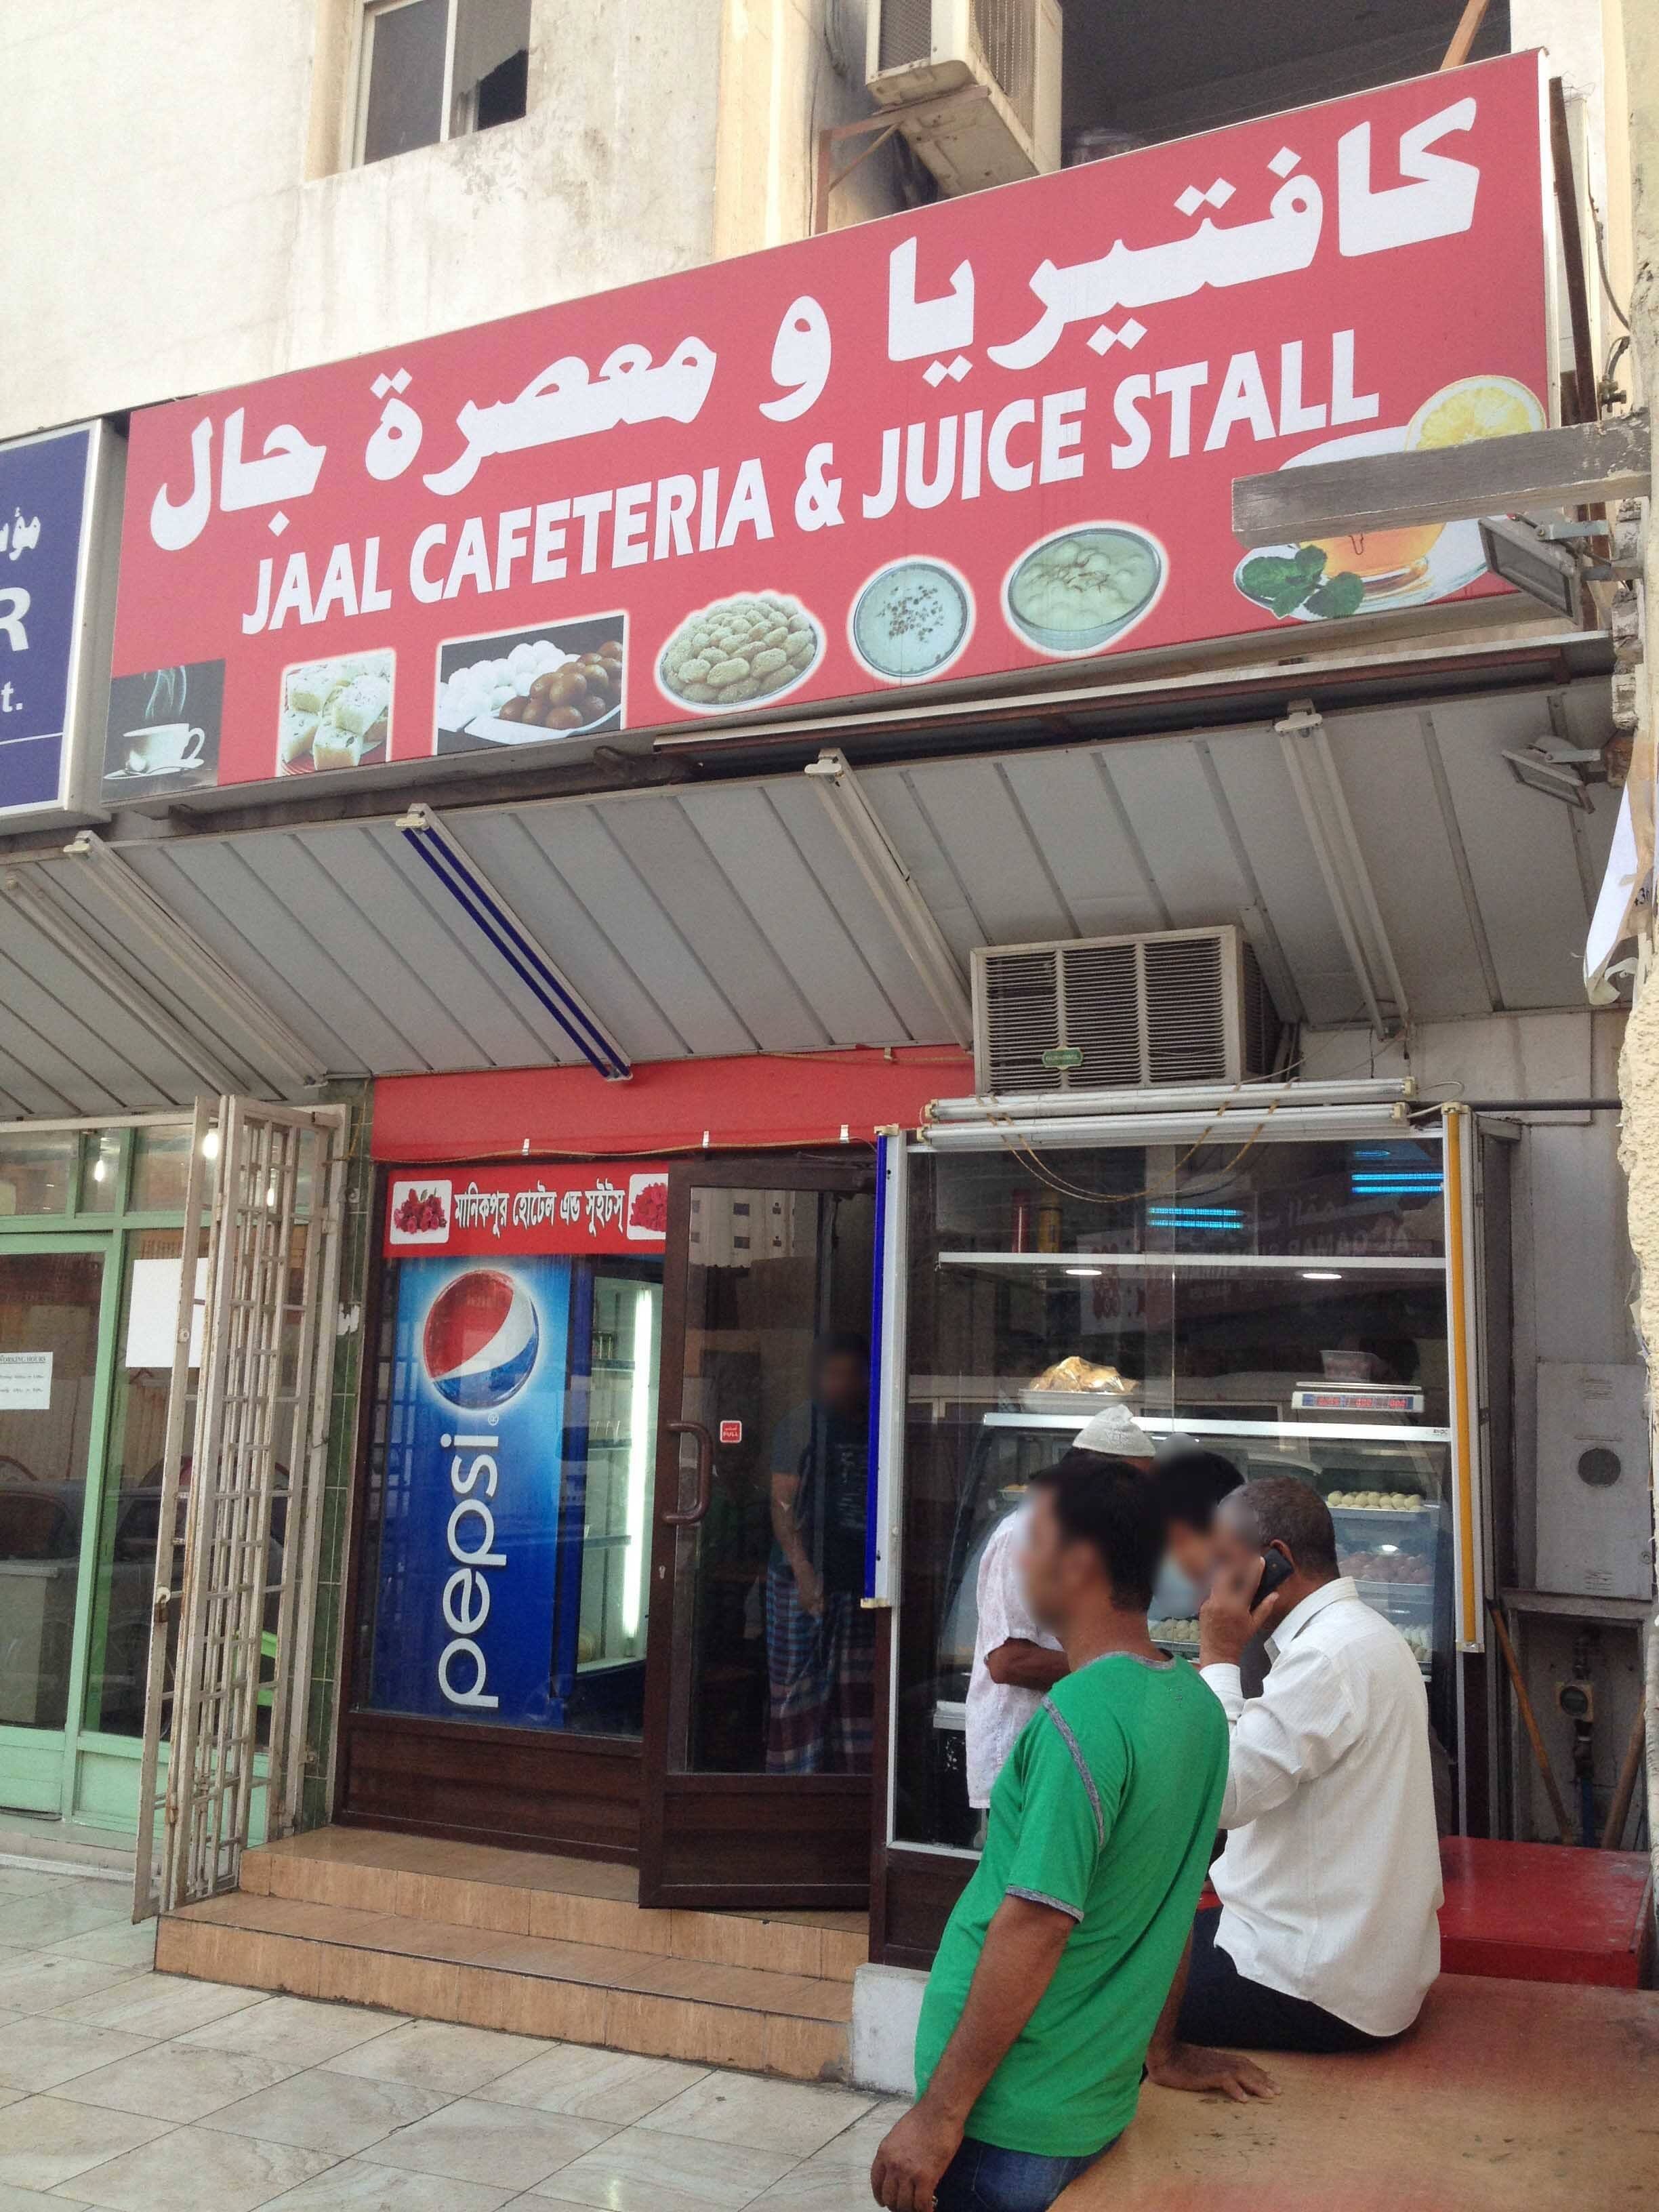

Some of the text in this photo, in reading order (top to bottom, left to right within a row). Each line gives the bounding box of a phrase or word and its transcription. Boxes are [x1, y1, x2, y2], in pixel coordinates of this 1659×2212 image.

[150, 97, 1480, 551] كافتيريا و معصرة جال
[242, 329, 1379, 635] JAAL CAFETERIA & JUICE STALL
[512, 1179, 558, 1229] হোটেল
[438, 1433, 507, 1708] pepsi
